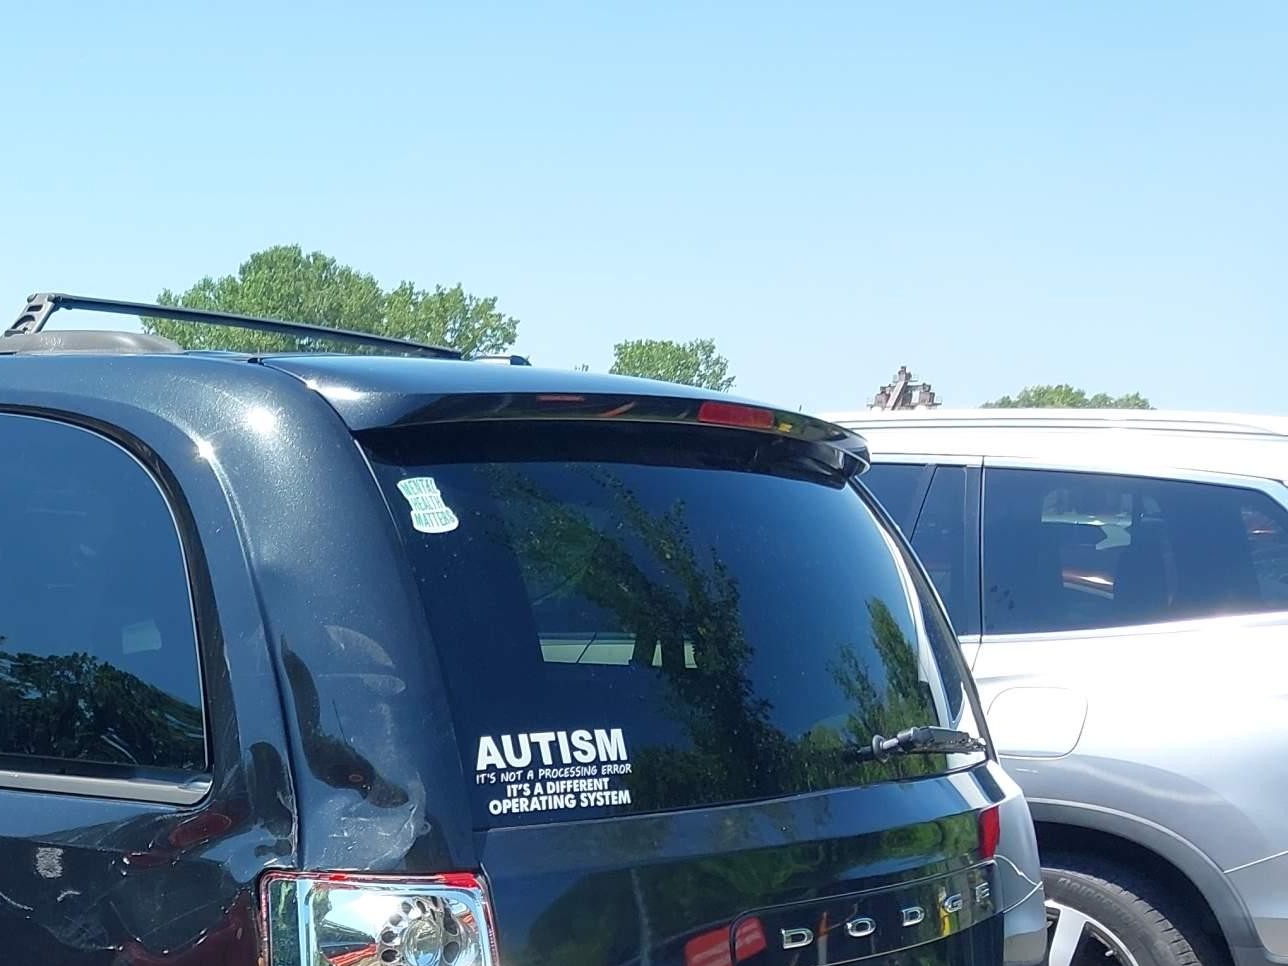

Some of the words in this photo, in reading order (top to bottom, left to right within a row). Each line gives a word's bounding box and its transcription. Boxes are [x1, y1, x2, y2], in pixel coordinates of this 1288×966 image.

[400, 479, 438, 496] MENTAL
[411, 495, 443, 511] HEALTH
[413, 509, 456, 528] MATTERS
[476, 728, 629, 771] AUTISM
[476, 772, 497, 785] IT'S
[500, 770, 524, 783] NOT
[527, 770, 534, 781] A
[538, 764, 598, 780] PROCESSING
[601, 763, 633, 775] ERROR
[506, 784, 531, 798] IT'S
[533, 783, 544, 796] A
[546, 778, 610, 795] DIFFERENT
[488, 793, 577, 815] OPERATING
[580, 789, 632, 808] SYSTEM
[781, 881, 991, 949] DODGE
